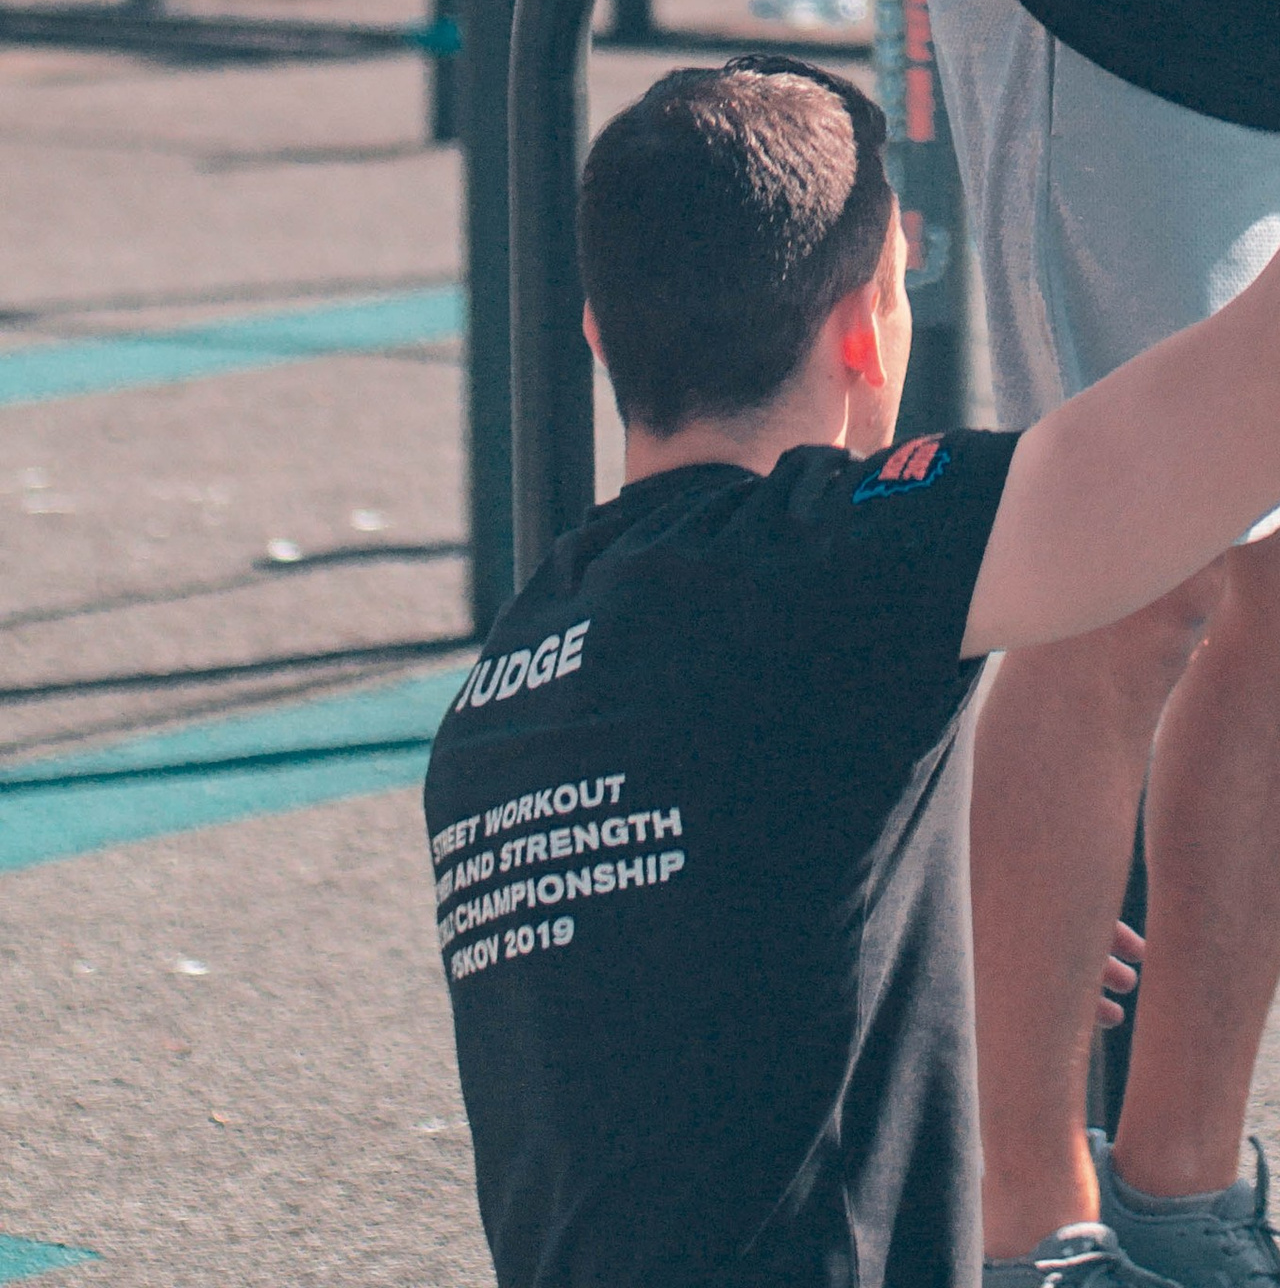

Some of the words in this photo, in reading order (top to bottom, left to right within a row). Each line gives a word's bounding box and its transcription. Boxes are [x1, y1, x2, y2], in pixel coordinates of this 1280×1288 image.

[484, 773, 626, 838] WORKOUT
[454, 849, 495, 891] AND
[500, 807, 683, 872] STRENGTH
[455, 850, 685, 935] CHAMPIONSHIP
[504, 916, 575, 959] 2019
